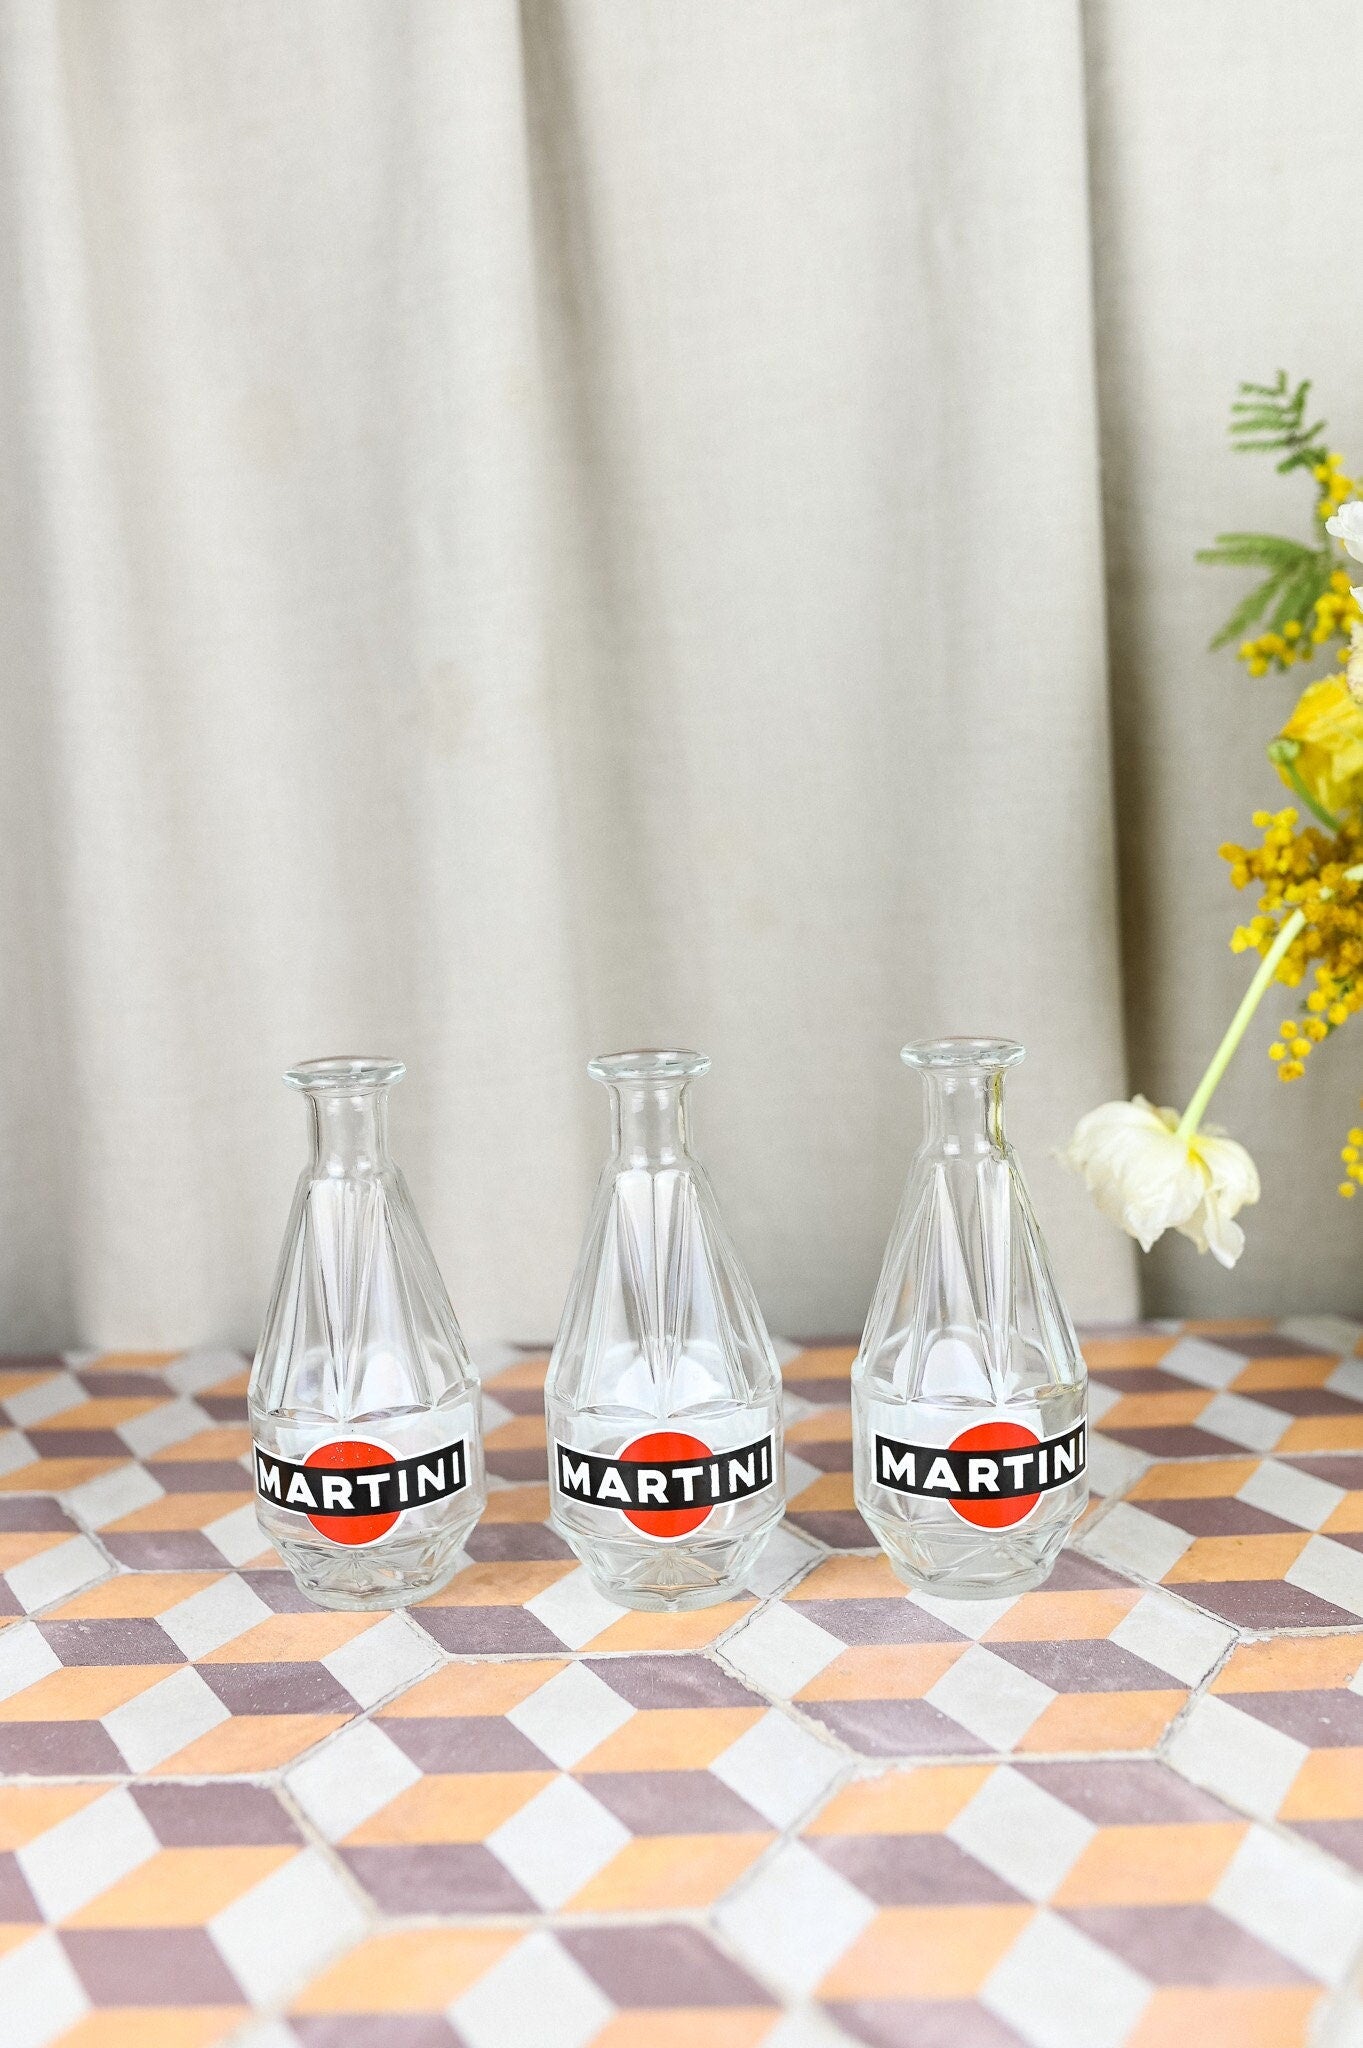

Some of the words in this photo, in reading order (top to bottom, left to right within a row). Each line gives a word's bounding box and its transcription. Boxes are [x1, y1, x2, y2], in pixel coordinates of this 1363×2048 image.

[258, 1450, 460, 1510] MARTINI
[561, 1446, 769, 1504] MARTINI
[881, 1430, 1084, 1493] MARTINI
